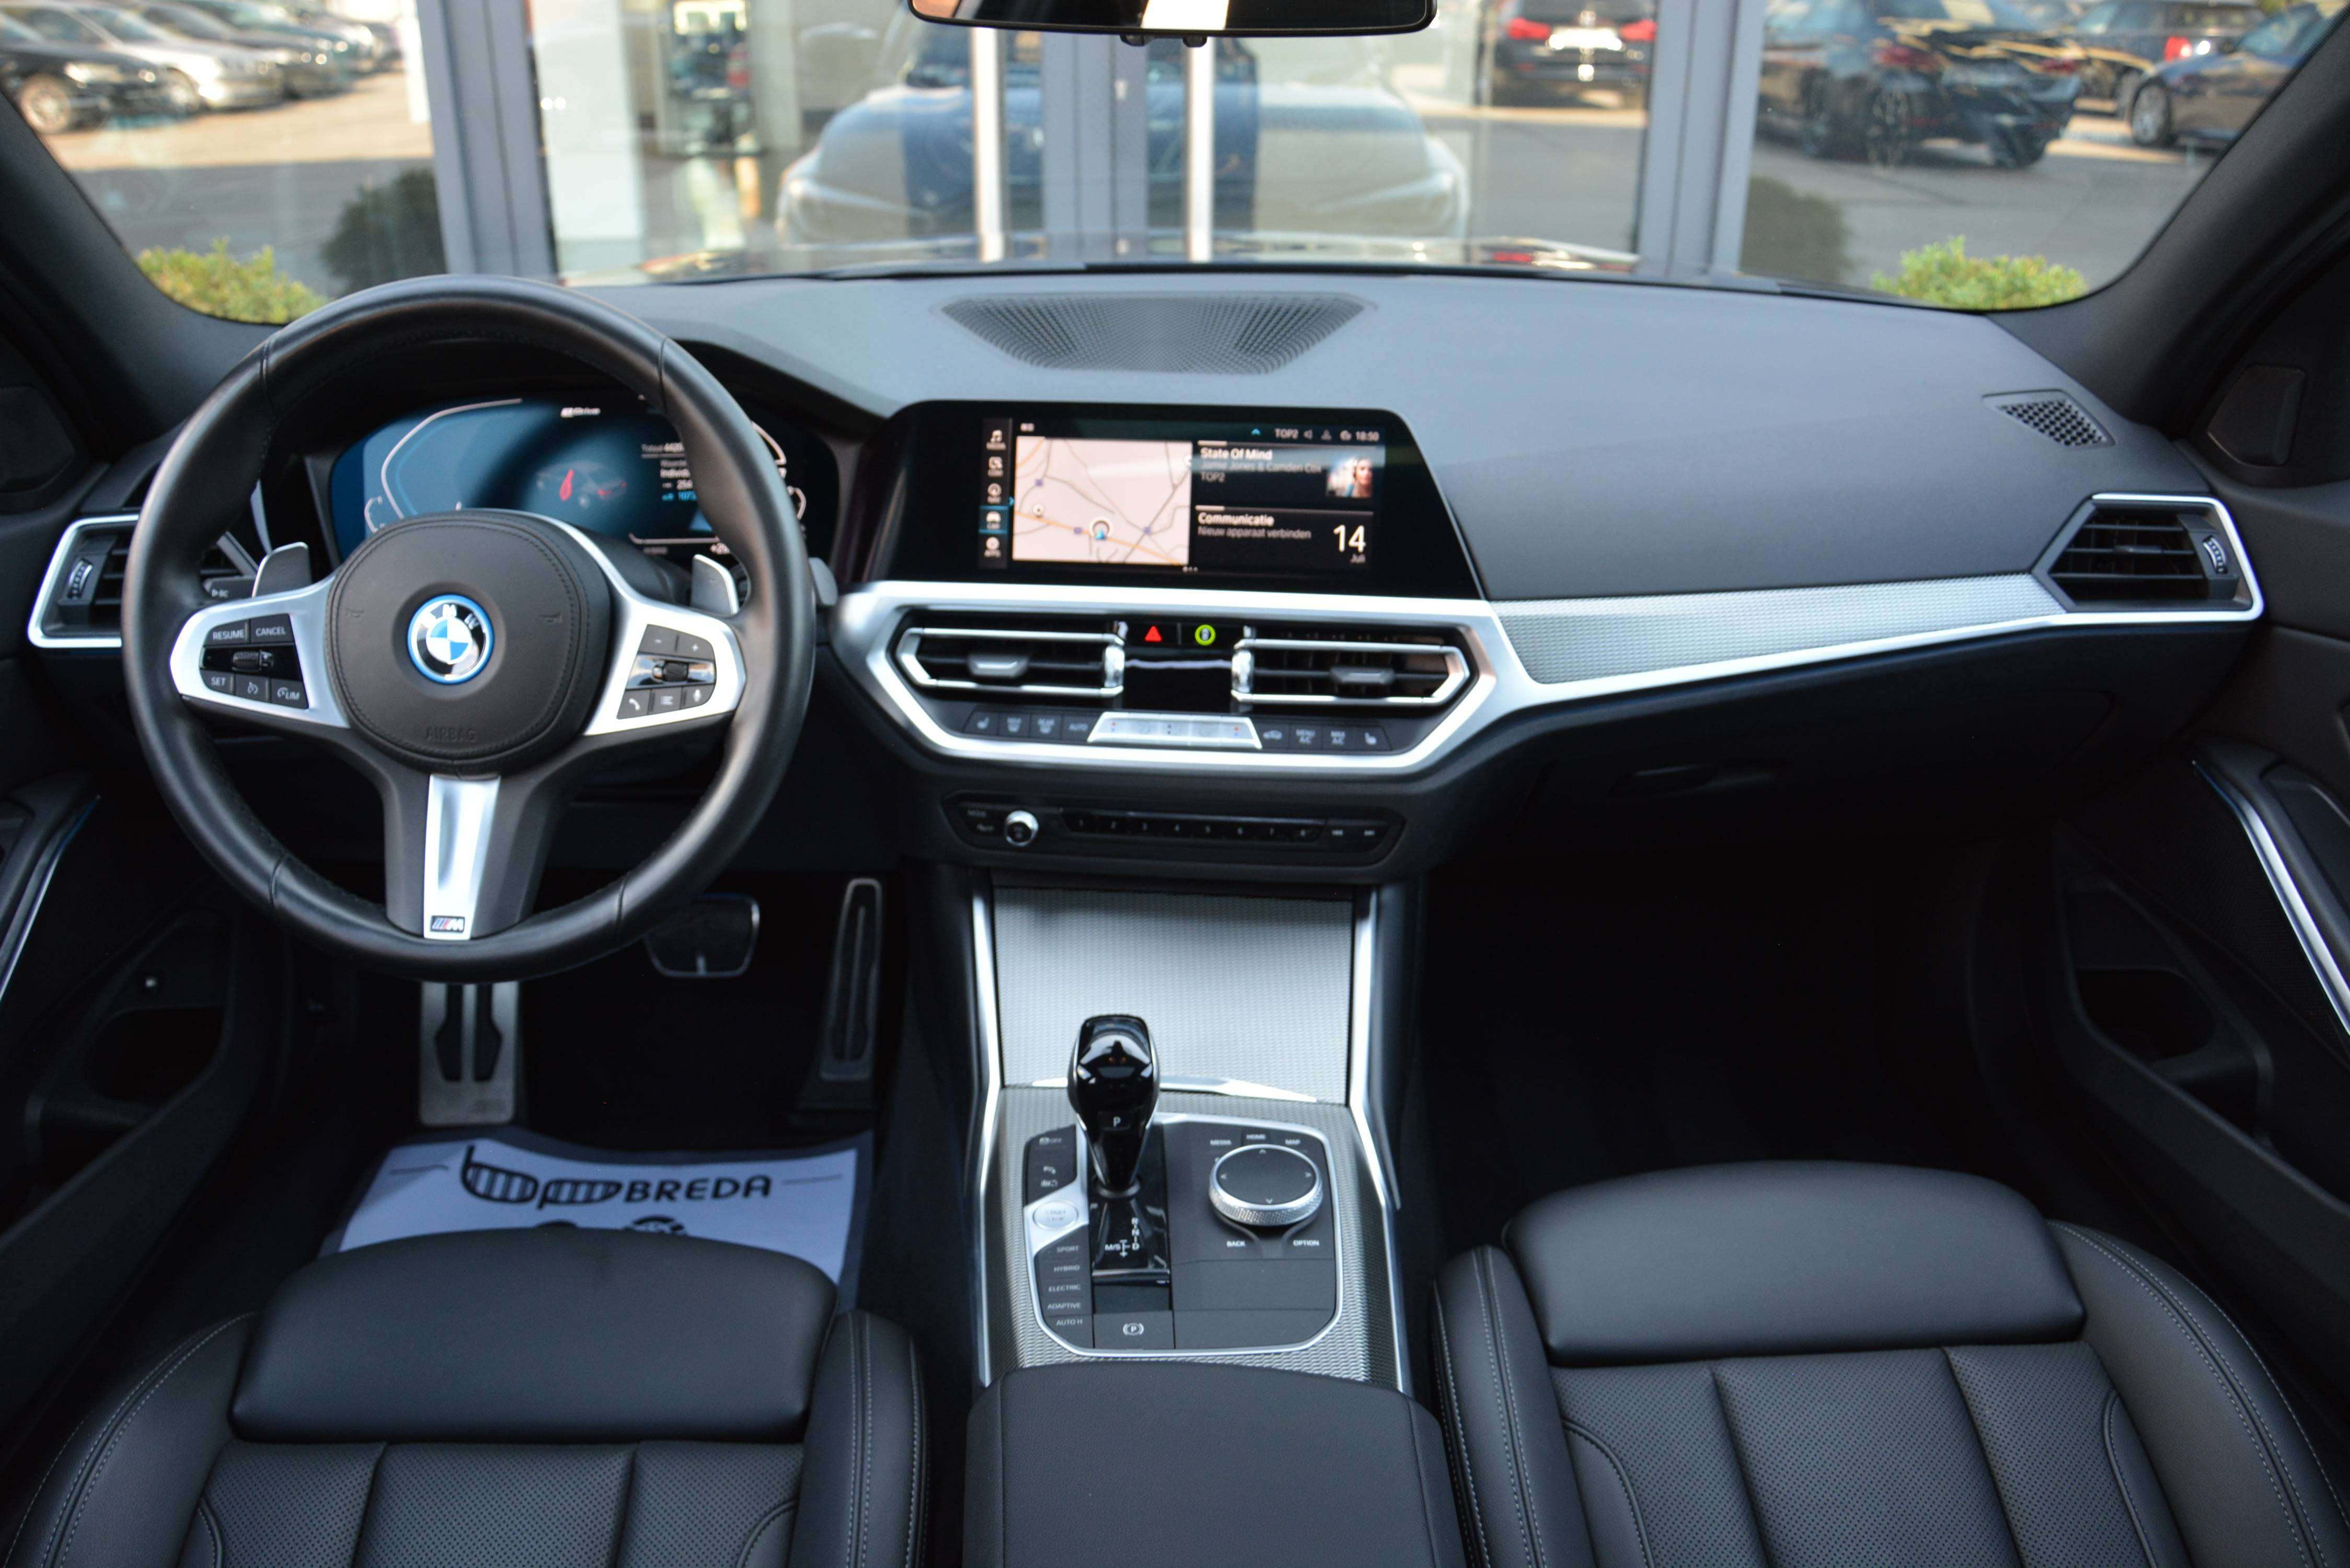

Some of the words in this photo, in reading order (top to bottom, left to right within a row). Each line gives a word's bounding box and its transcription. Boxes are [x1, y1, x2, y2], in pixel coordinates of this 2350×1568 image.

[1200, 447, 1228, 459] State
[1230, 448, 1245, 459] Of
[1245, 449, 1273, 460] Mind
[1197, 512, 1274, 526] Communicatie
[1197, 526, 1225, 536] Nieuw
[1226, 528, 1266, 539] apparaat
[1266, 529, 1311, 539] verbinden
[1333, 524, 1366, 552] 14
[212, 629, 245, 641] RESUME
[256, 626, 286, 637] CANCEL
[211, 676, 226, 686] SET
[285, 690, 301, 700] LIM
[1069, 722, 1088, 731] AUTO
[1113, 1116, 1121, 1127] P
[624, 1174, 772, 1203] BREDA
[1132, 1242, 1139, 1251] D
[1048, 1284, 1081, 1293] ELECTRIC
